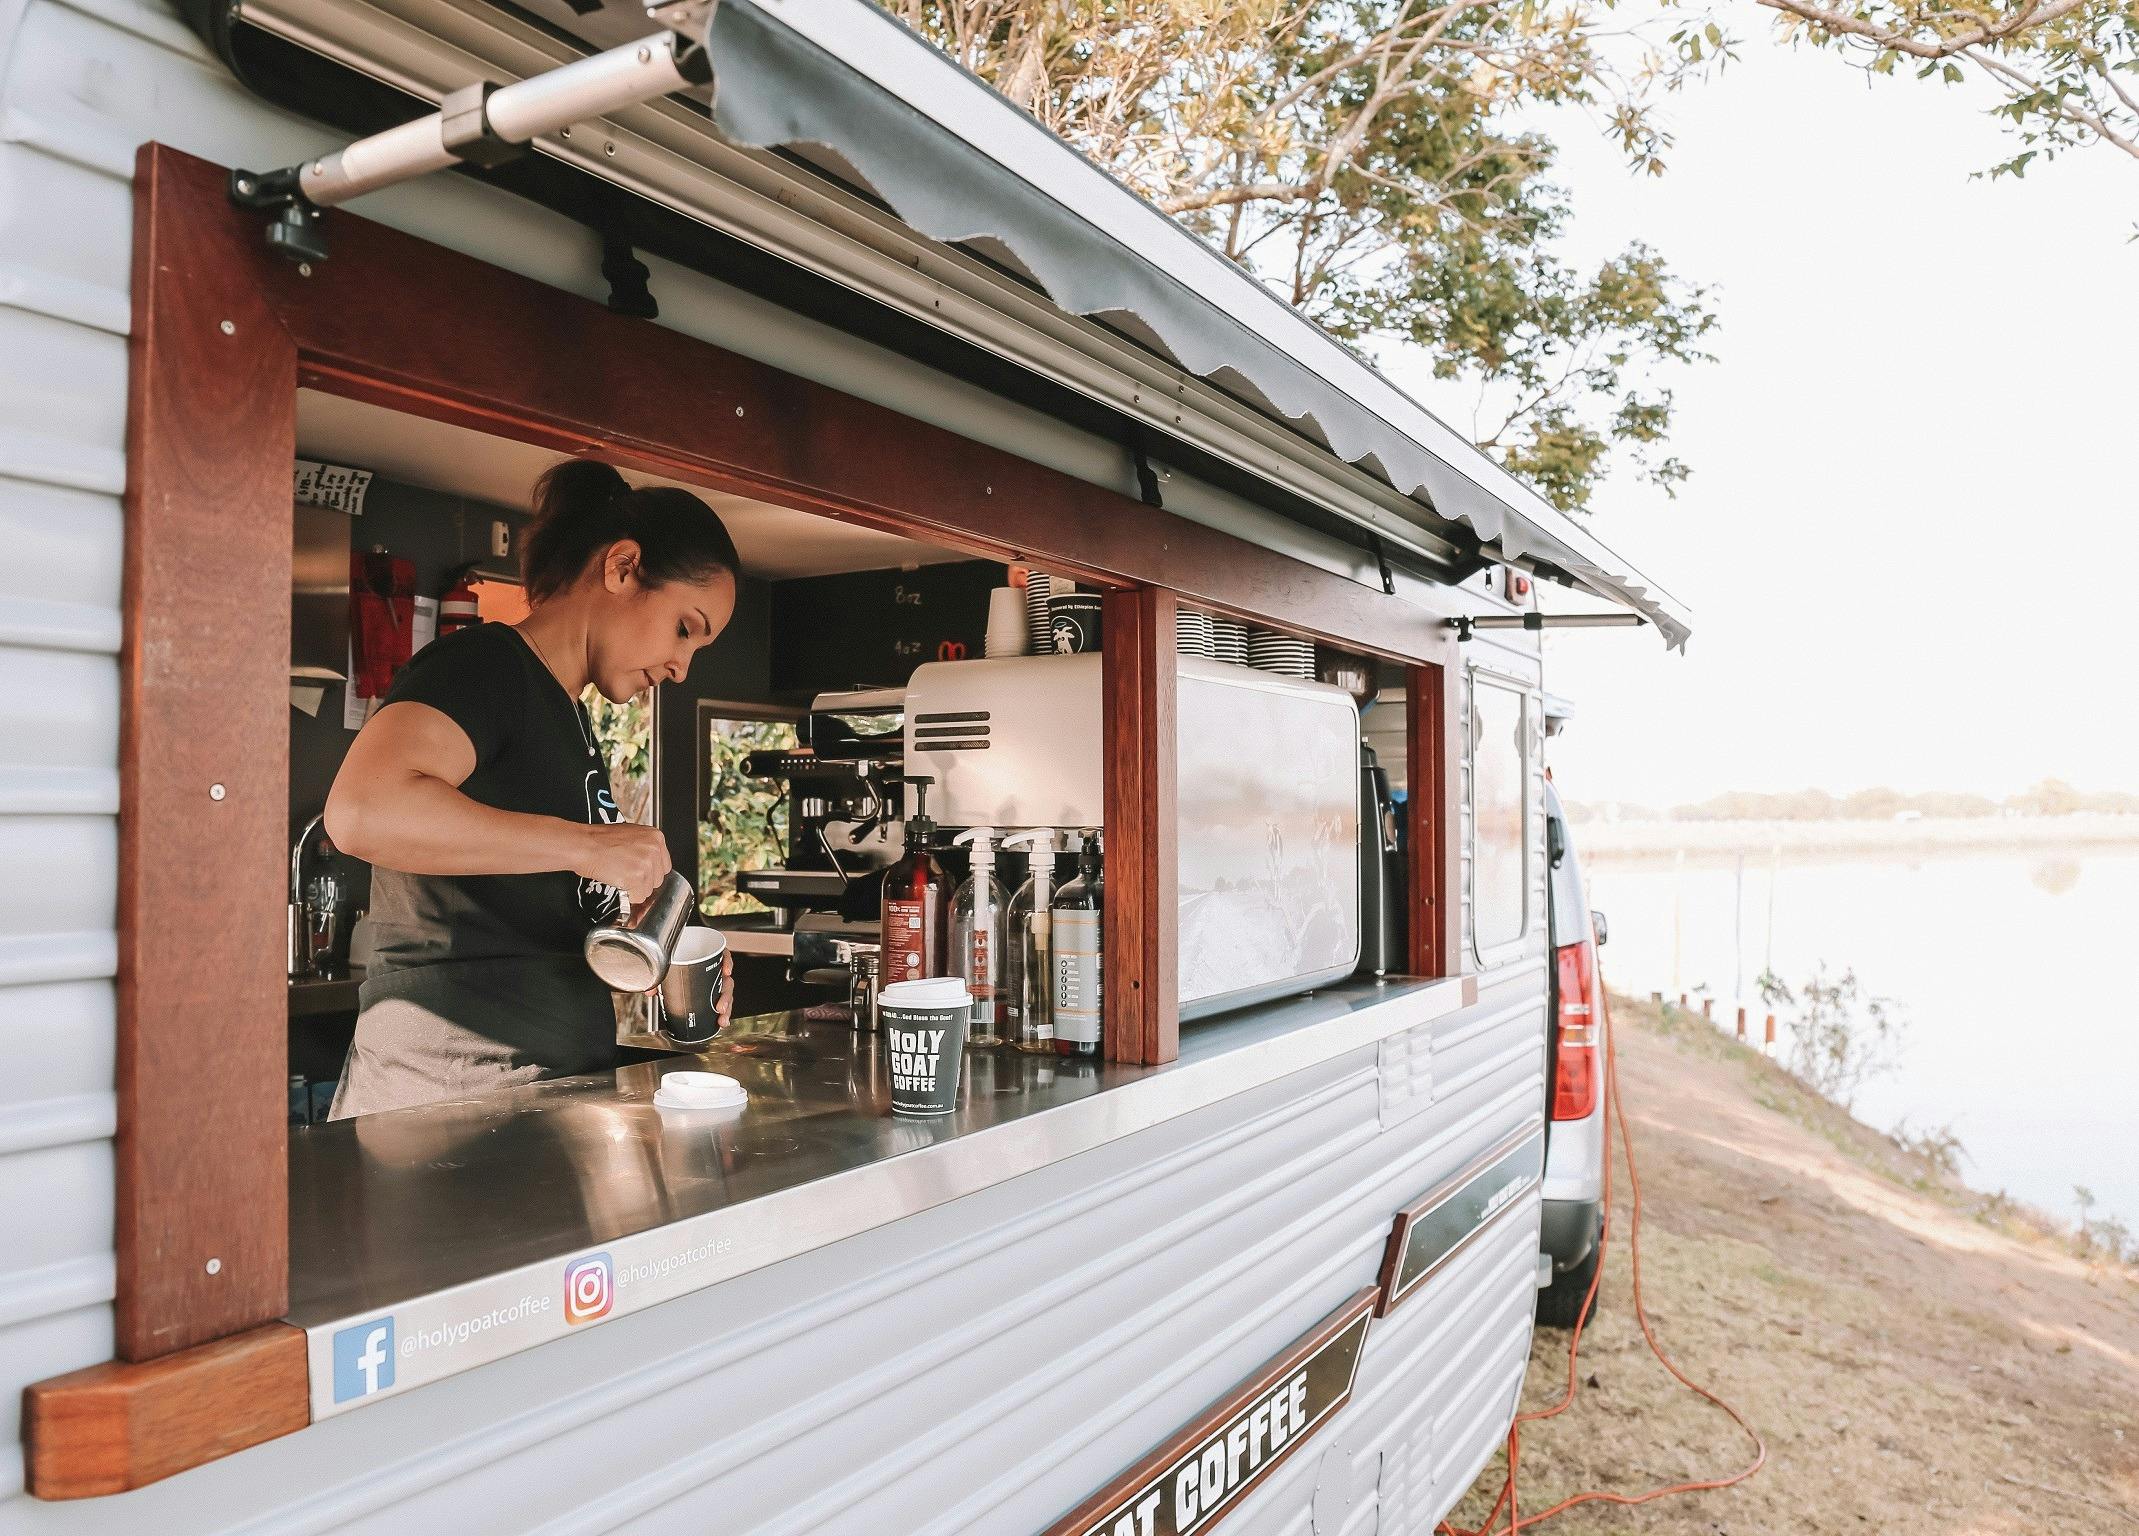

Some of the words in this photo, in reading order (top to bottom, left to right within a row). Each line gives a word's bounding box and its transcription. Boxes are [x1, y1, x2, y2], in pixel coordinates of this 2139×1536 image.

[889, 1027, 946, 1054] HOLY
[891, 1051, 941, 1076] GOAT
[893, 1074, 937, 1092] COFFEE
[616, 1237, 732, 1288] @holygoatcoffee
[400, 1295, 551, 1358] @holygoatcoffee
[1175, 1370, 1308, 1534] COFFEE
